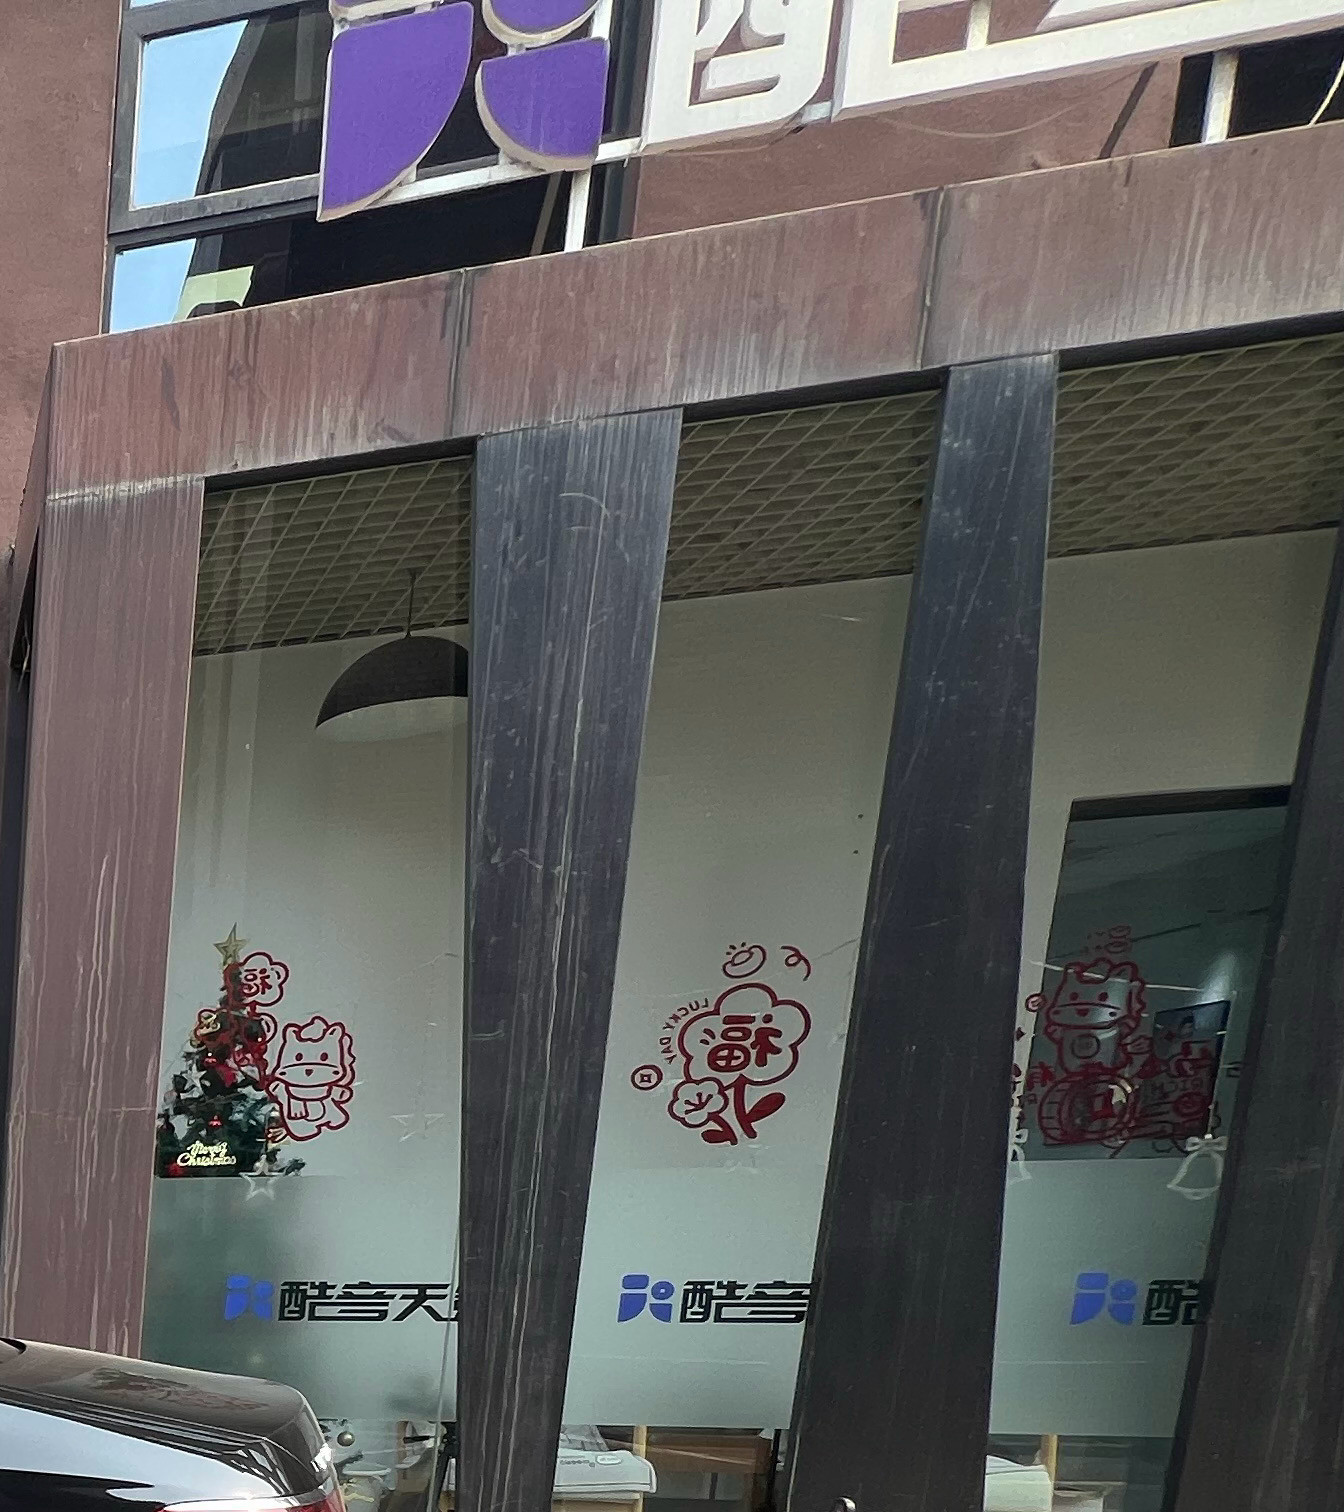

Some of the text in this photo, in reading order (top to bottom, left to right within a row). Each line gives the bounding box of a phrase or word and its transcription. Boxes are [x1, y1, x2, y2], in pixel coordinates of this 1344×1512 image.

[278, 1280, 459, 1322] 酷音天
[679, 1280, 812, 1323] 酷音
